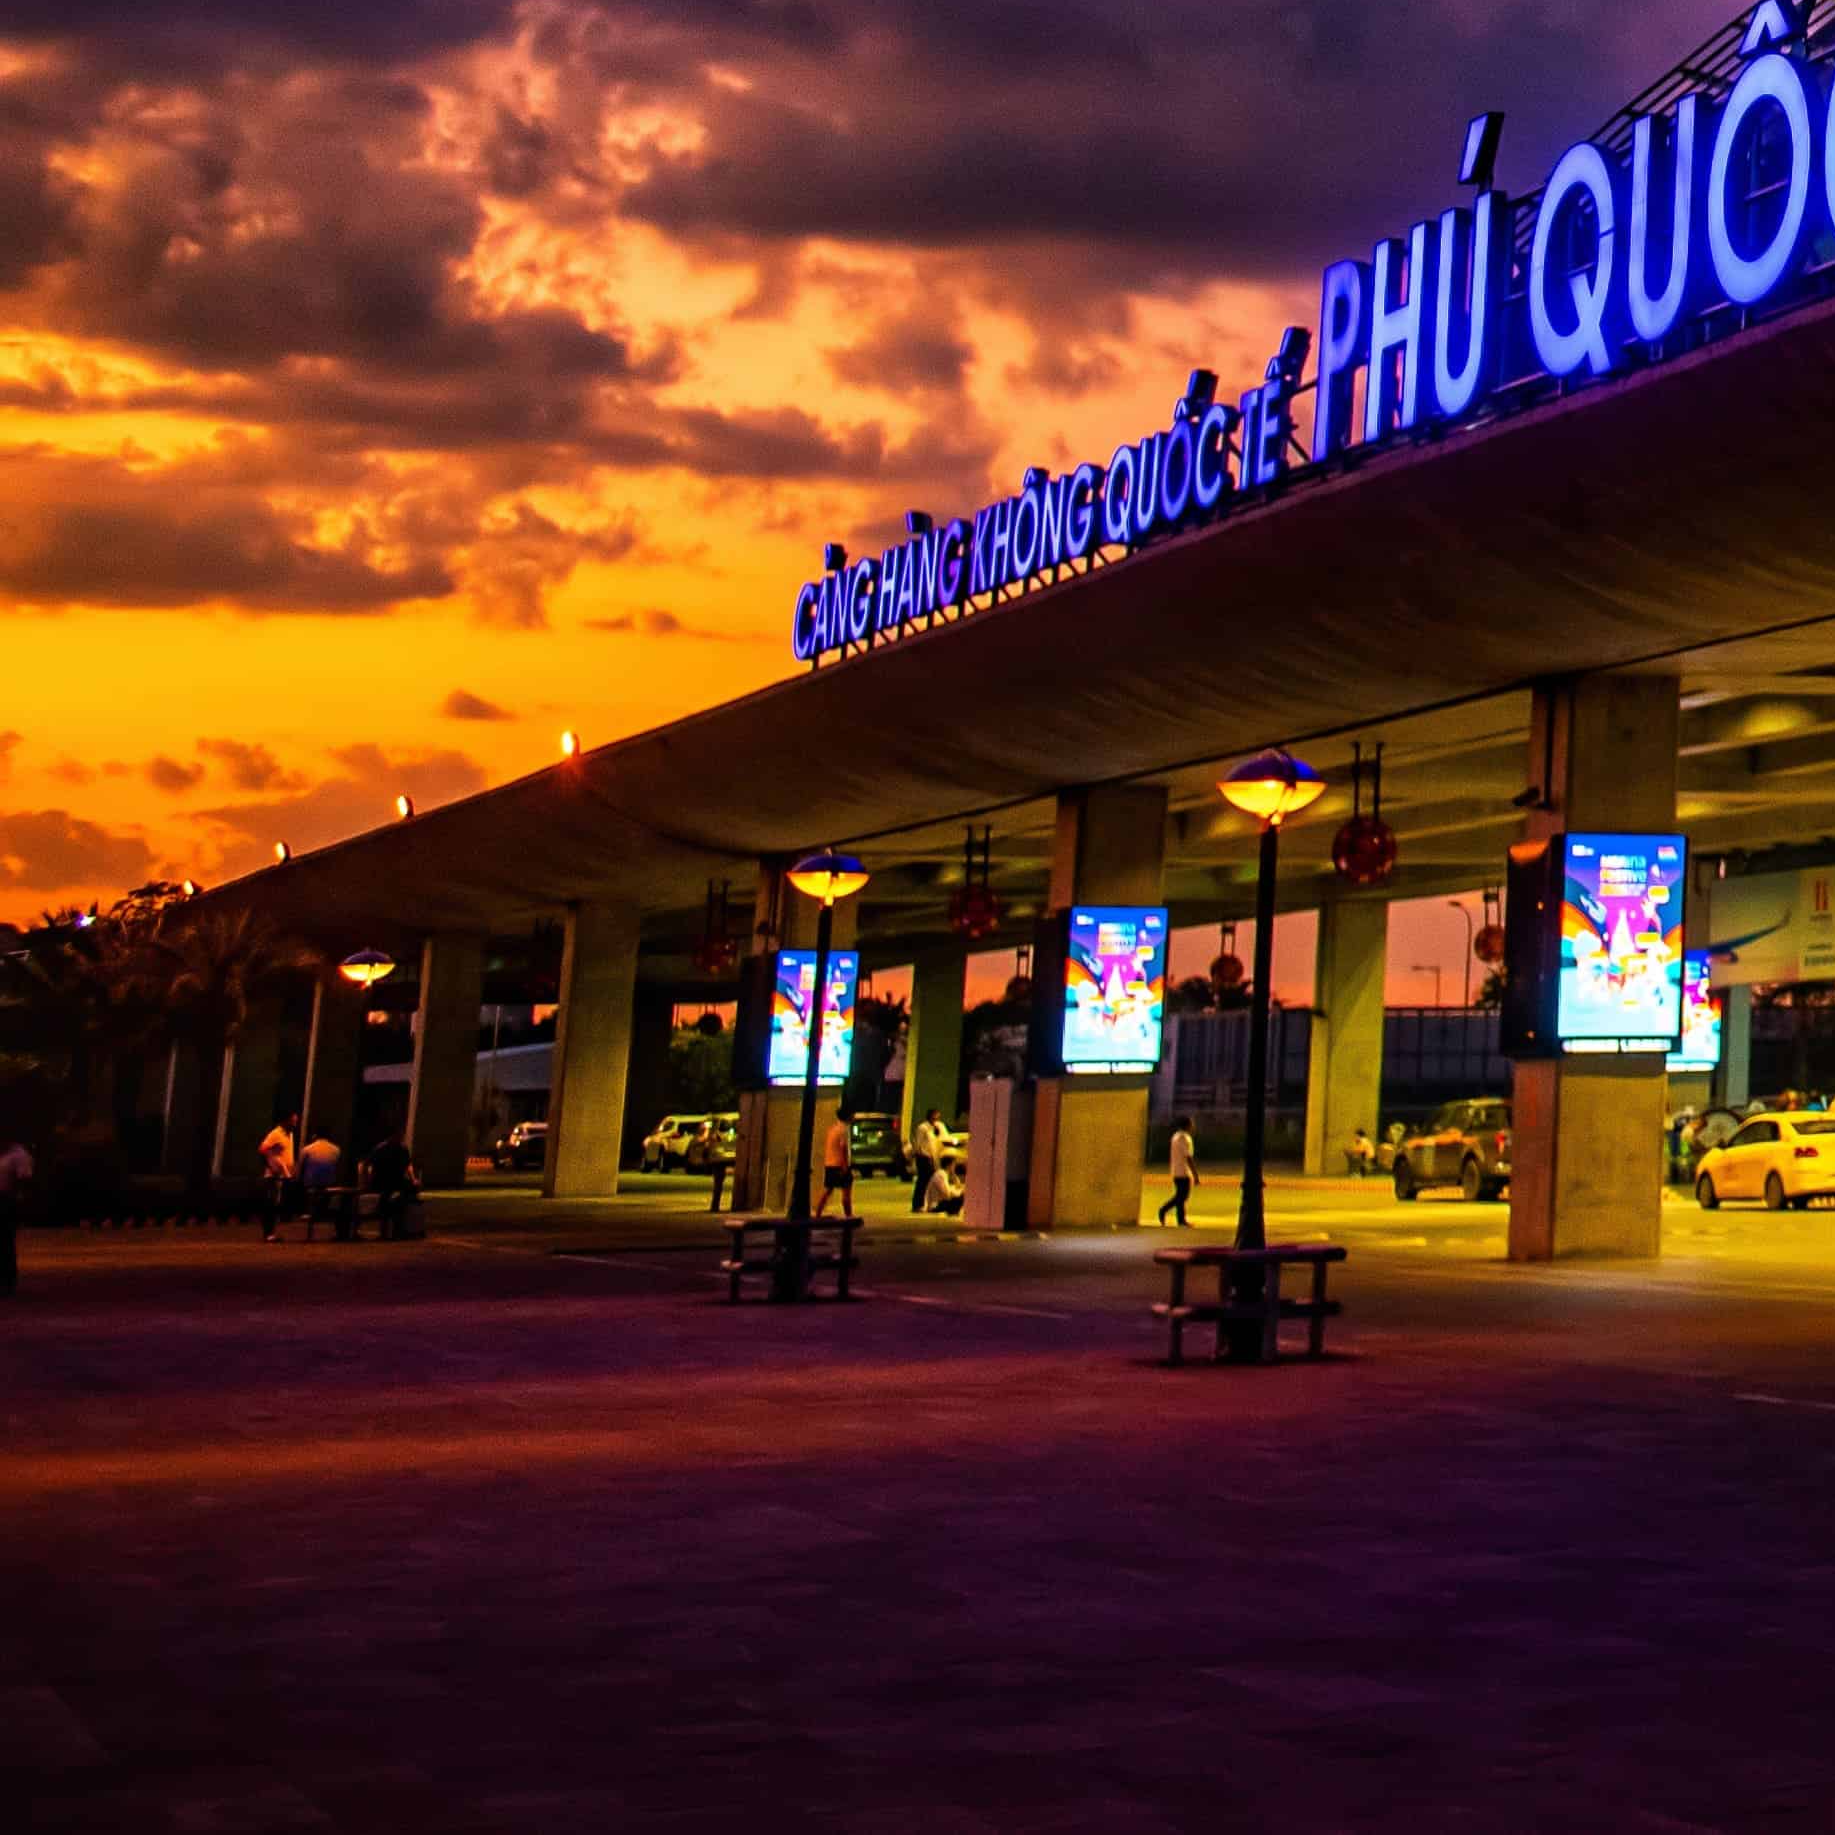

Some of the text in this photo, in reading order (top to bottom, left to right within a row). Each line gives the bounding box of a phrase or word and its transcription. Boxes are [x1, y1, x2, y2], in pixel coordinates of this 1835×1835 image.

[876, 512, 972, 626] HÀNG
[968, 463, 1104, 594] KHÔNG
[1104, 369, 1238, 540] QUỐC
[1240, 327, 1310, 491] TẾ
[1313, 112, 1506, 463] PHÚ
